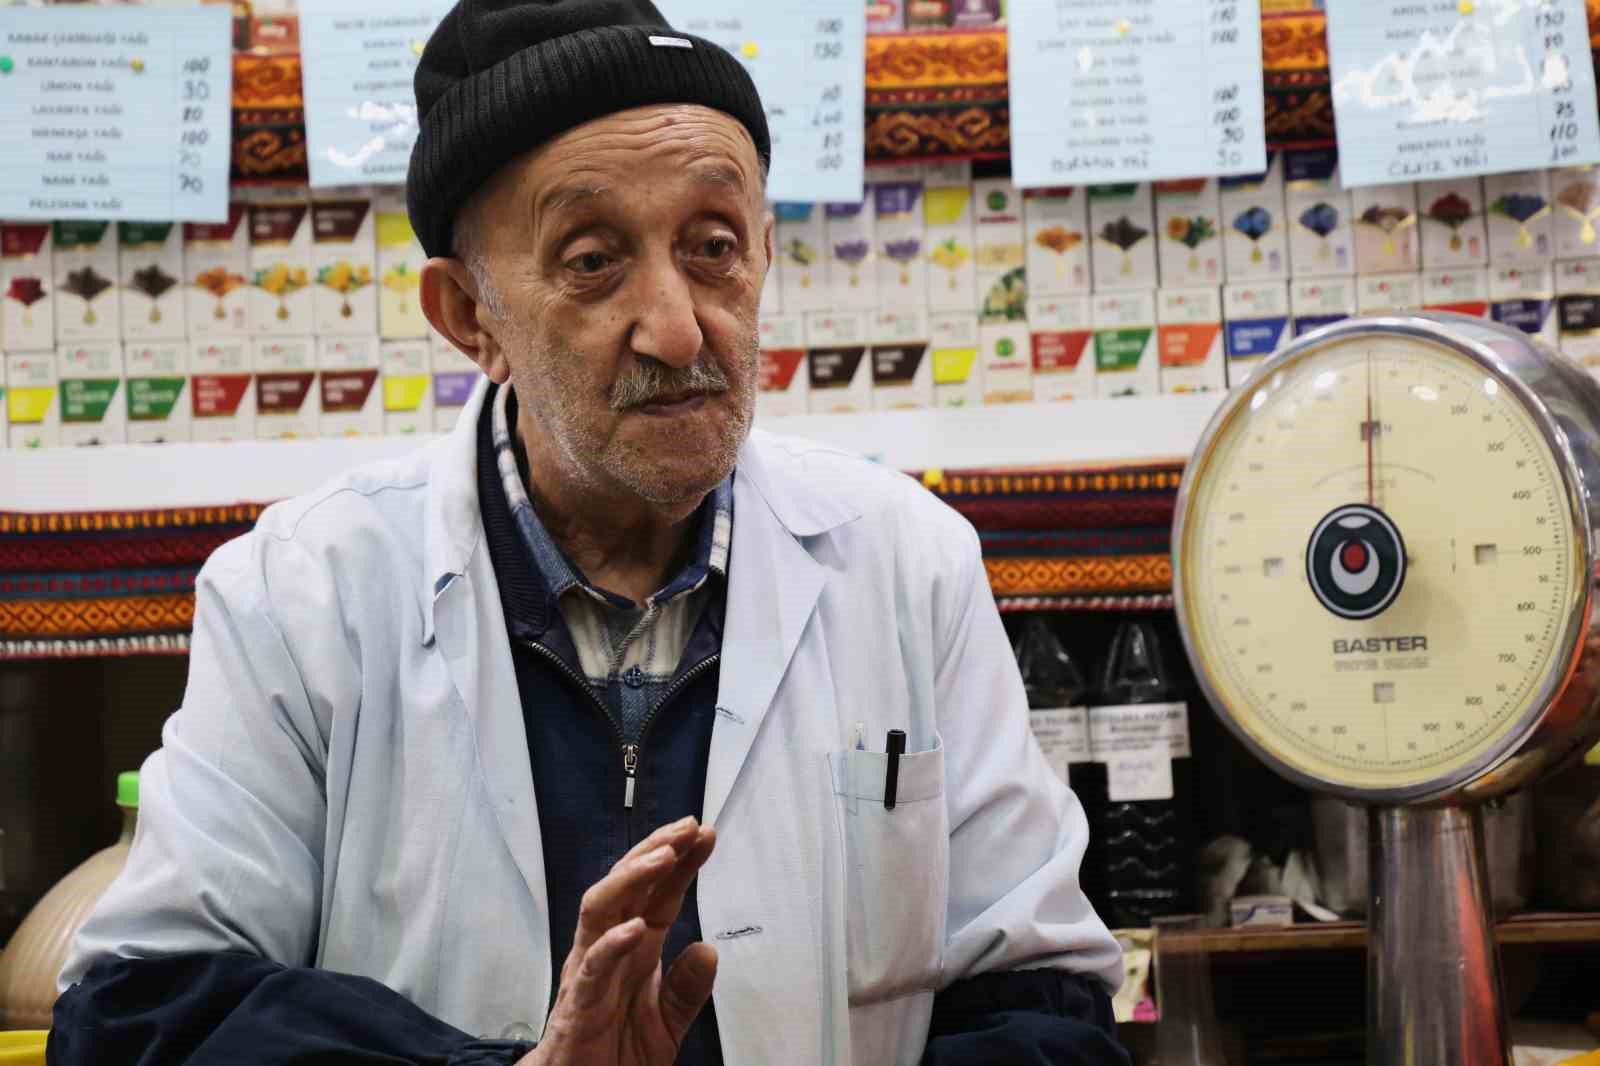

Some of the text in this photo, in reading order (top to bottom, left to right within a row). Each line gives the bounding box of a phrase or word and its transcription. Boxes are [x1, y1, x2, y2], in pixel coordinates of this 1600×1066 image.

[1521, 544, 1542, 556] 500
[1333, 635, 1428, 655] BASTER
[1497, 652, 1516, 664] 700
